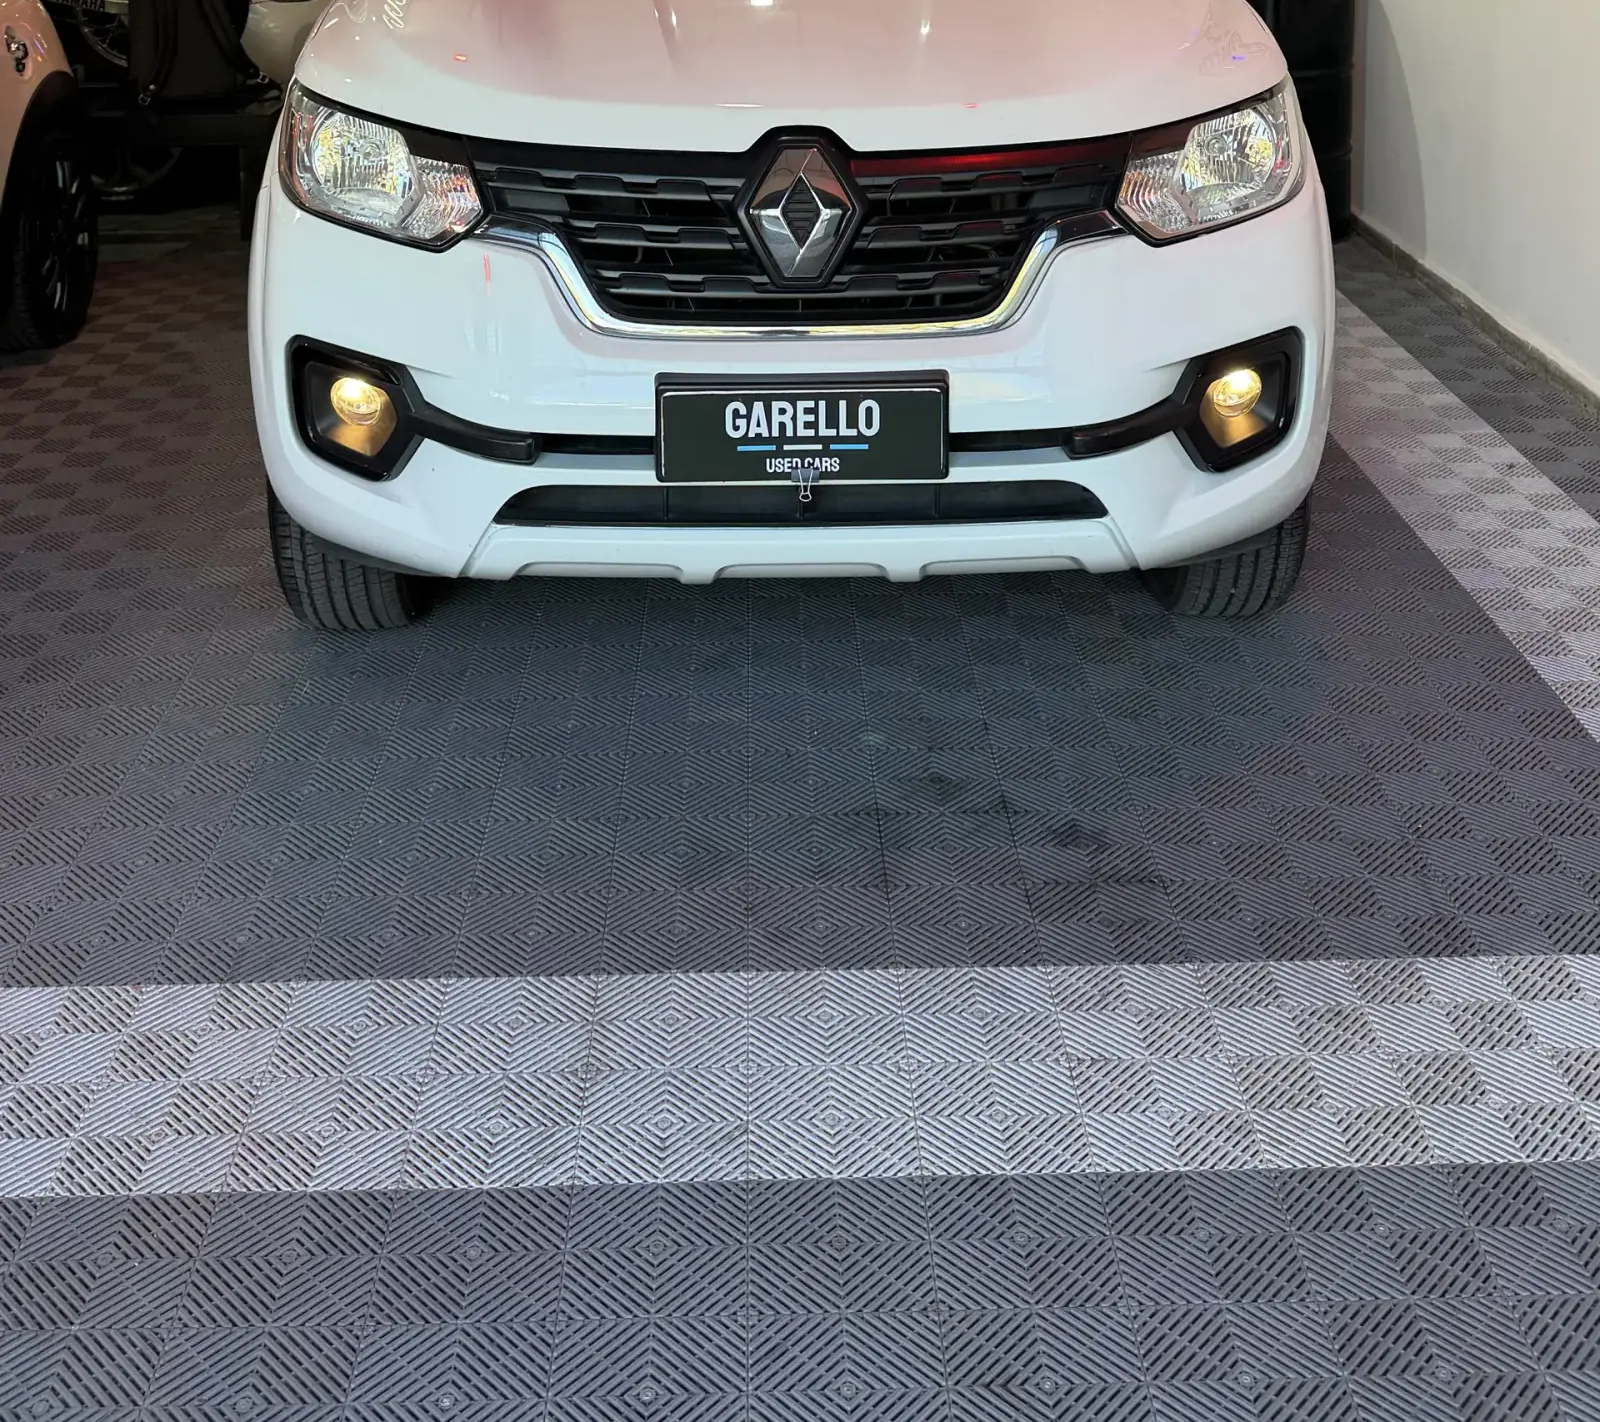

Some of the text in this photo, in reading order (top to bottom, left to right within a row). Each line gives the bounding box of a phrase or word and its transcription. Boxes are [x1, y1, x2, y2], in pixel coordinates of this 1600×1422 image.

[725, 399, 881, 439] GARELLO
[766, 457, 840, 473] USED CARS
